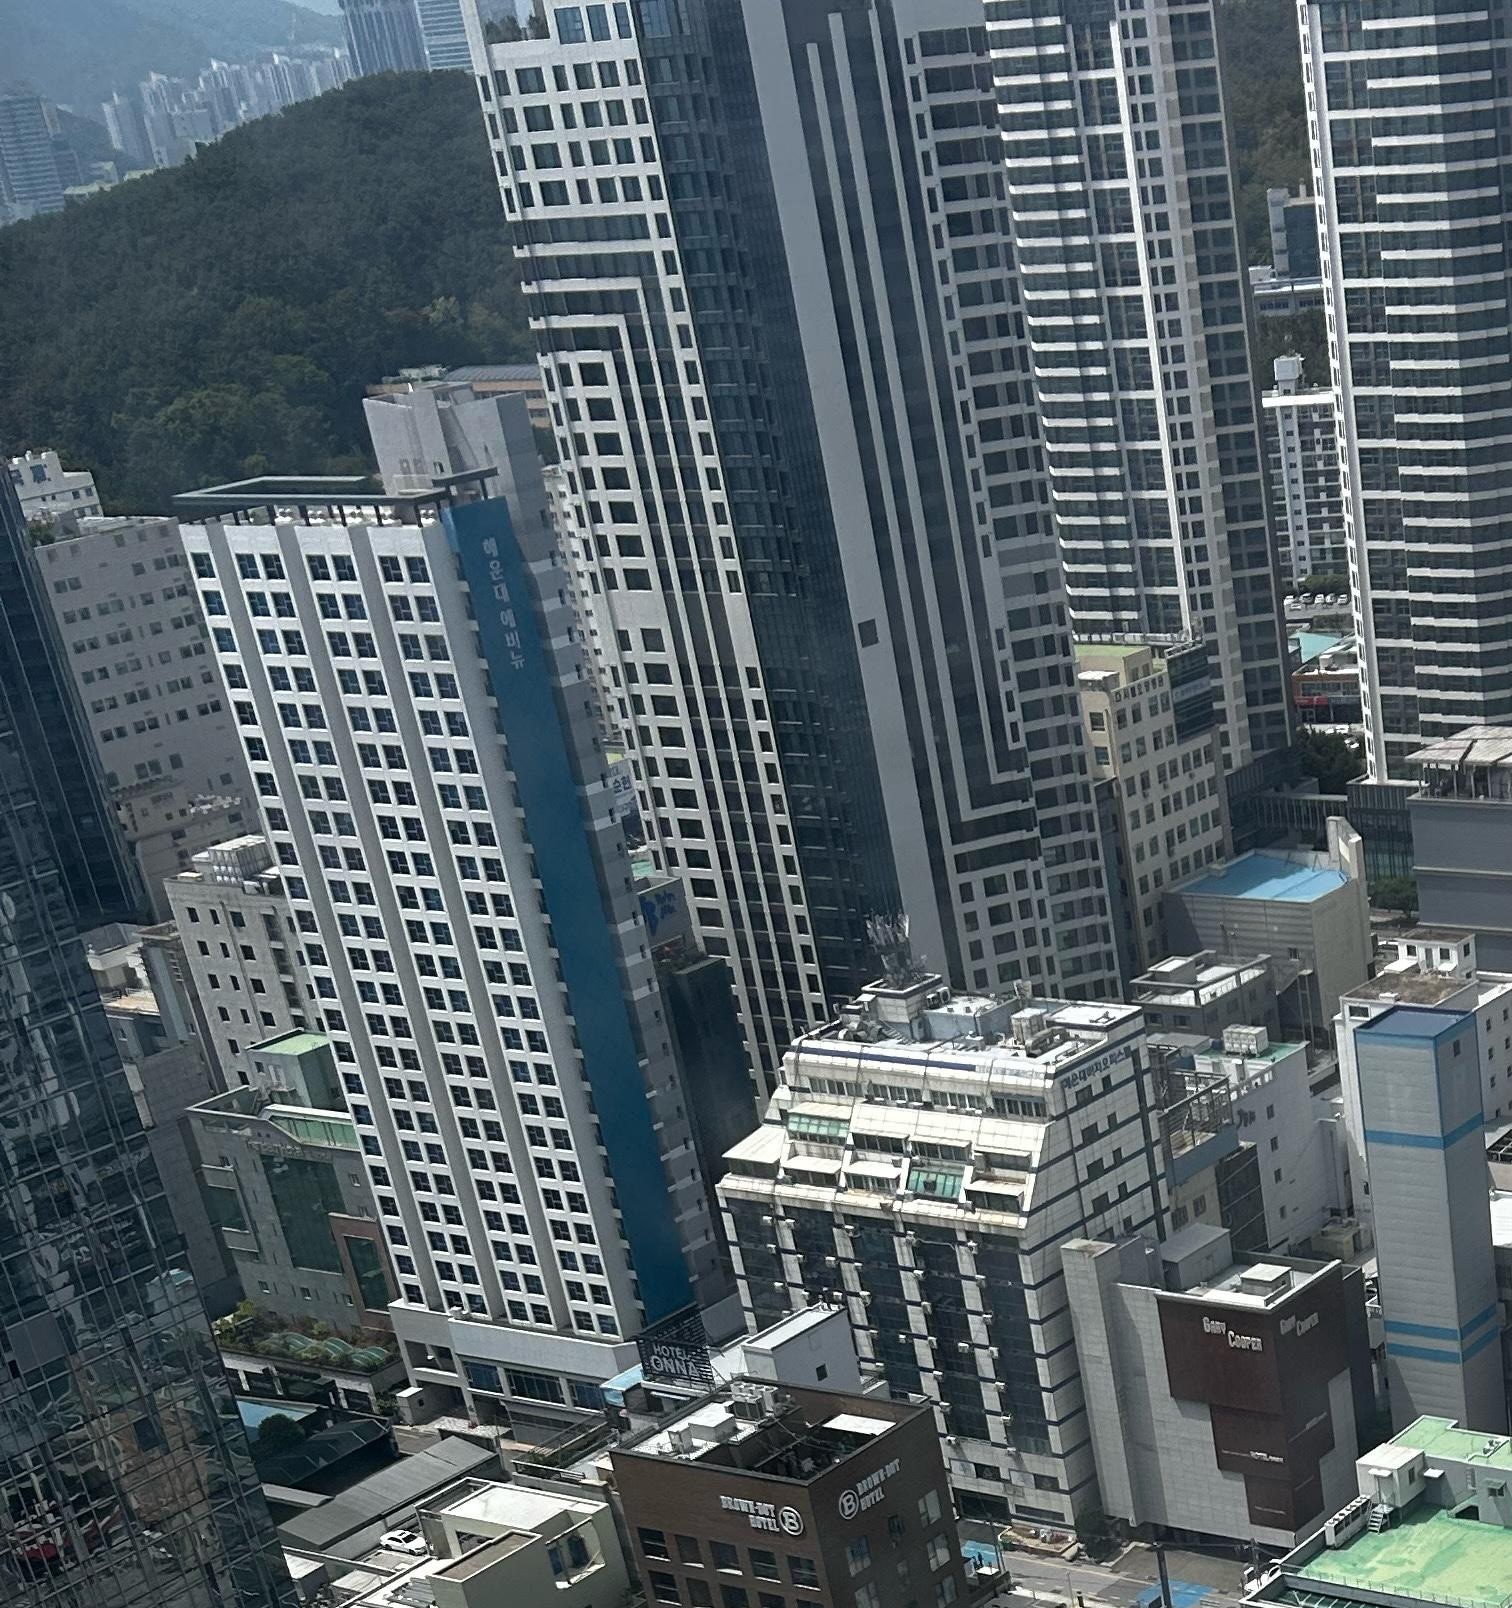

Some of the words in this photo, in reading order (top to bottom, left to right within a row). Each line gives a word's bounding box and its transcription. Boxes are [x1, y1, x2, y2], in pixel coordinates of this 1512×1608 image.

[482, 537, 526, 670] 해운대에비뉴
[653, 1342, 691, 1360] HOTEL
[651, 1355, 700, 1377] ONNA
